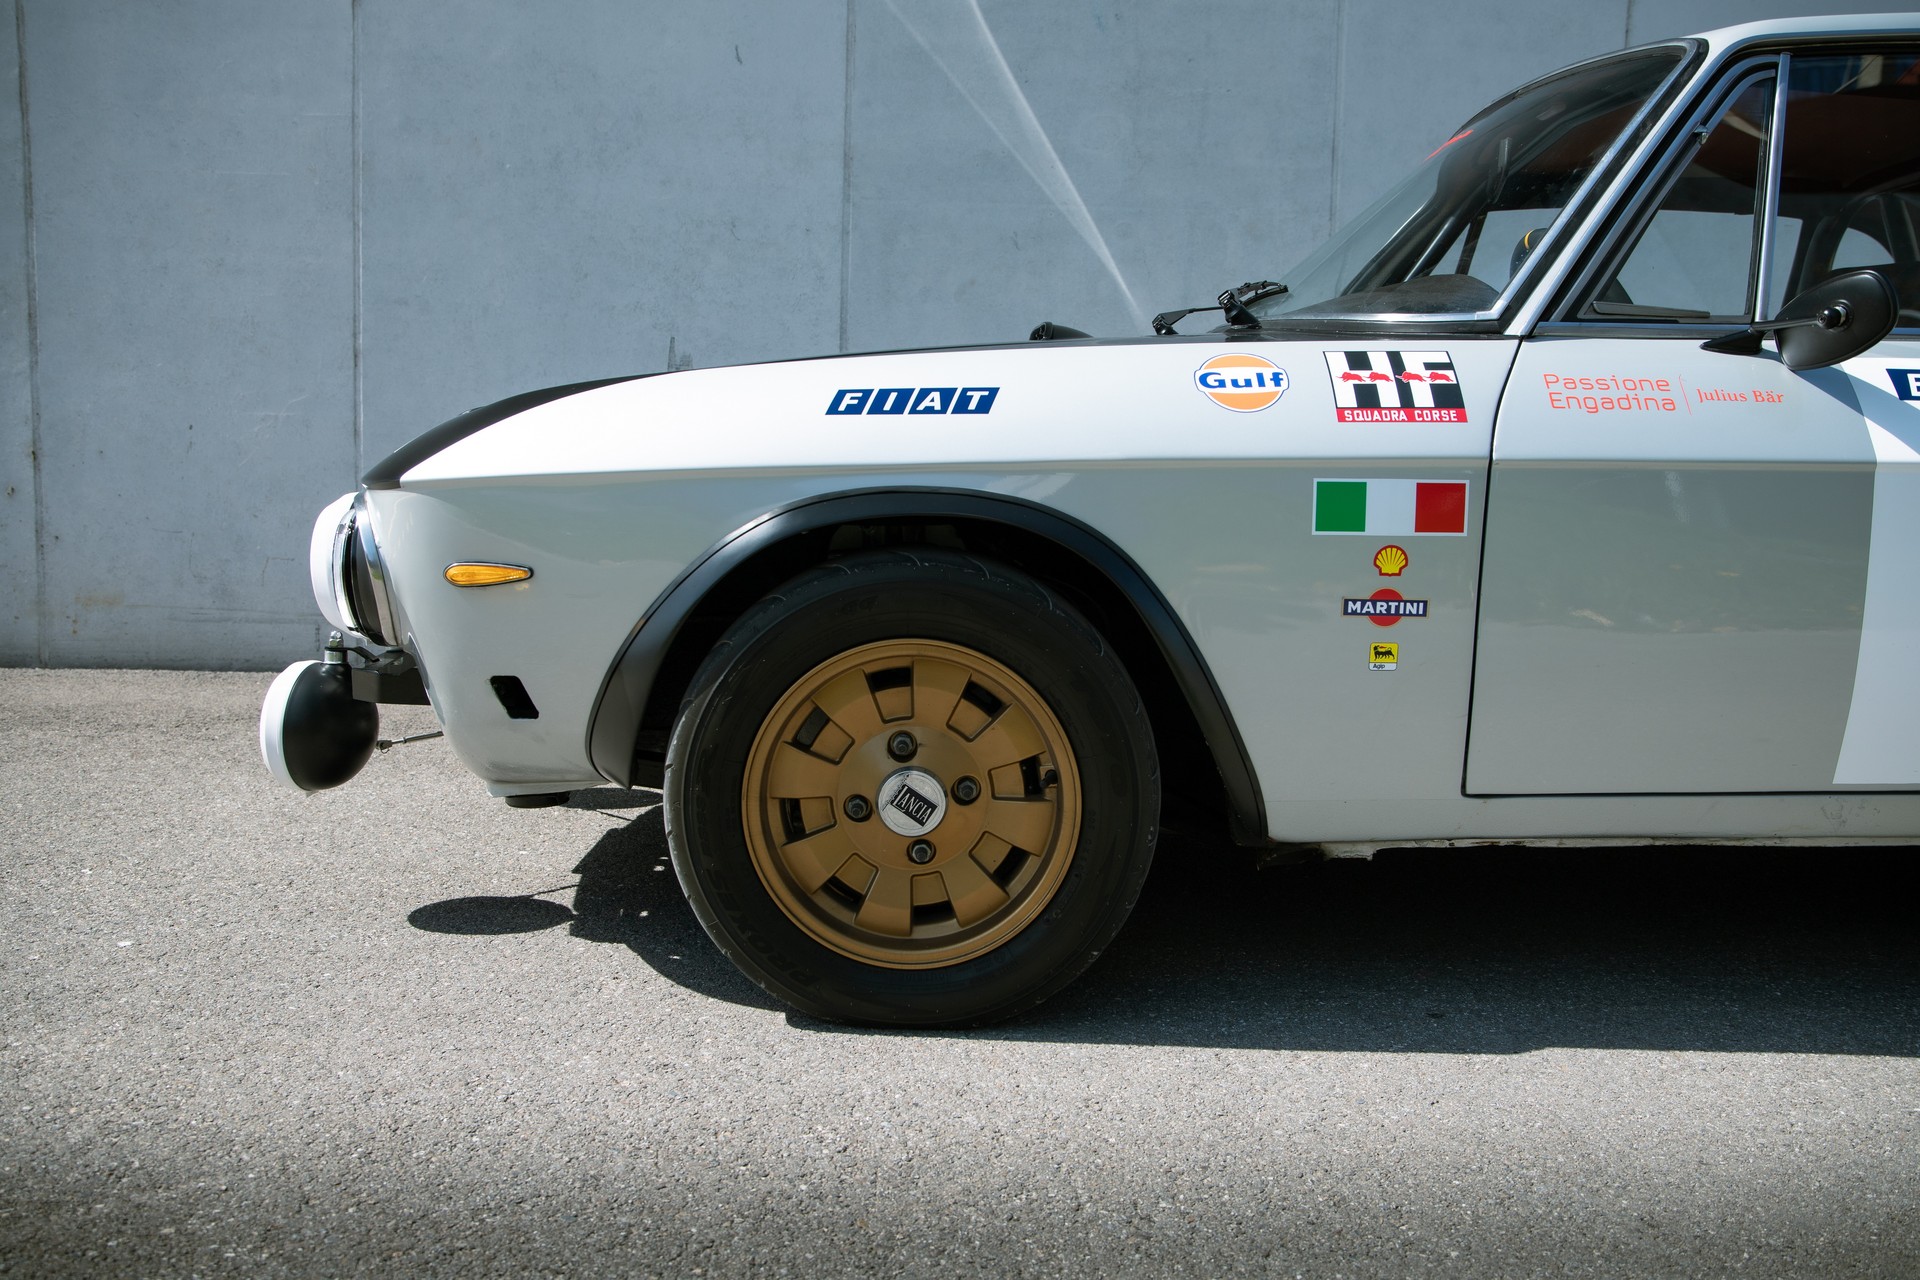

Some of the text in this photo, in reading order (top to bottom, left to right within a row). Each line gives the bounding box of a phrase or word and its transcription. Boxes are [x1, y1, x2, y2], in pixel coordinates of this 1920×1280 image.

[1198, 371, 1284, 389] Gulf
[1324, 351, 1457, 408] HF
[1543, 373, 1671, 392] Passione
[837, 390, 990, 412] FIAT
[1548, 391, 1677, 414] Engadina
[1696, 388, 1785, 403] Julius Bär
[1343, 410, 1458, 422] SQUADRA CORSE
[1347, 600, 1424, 615] MARTINI
[892, 785, 932, 823] LANCIA
